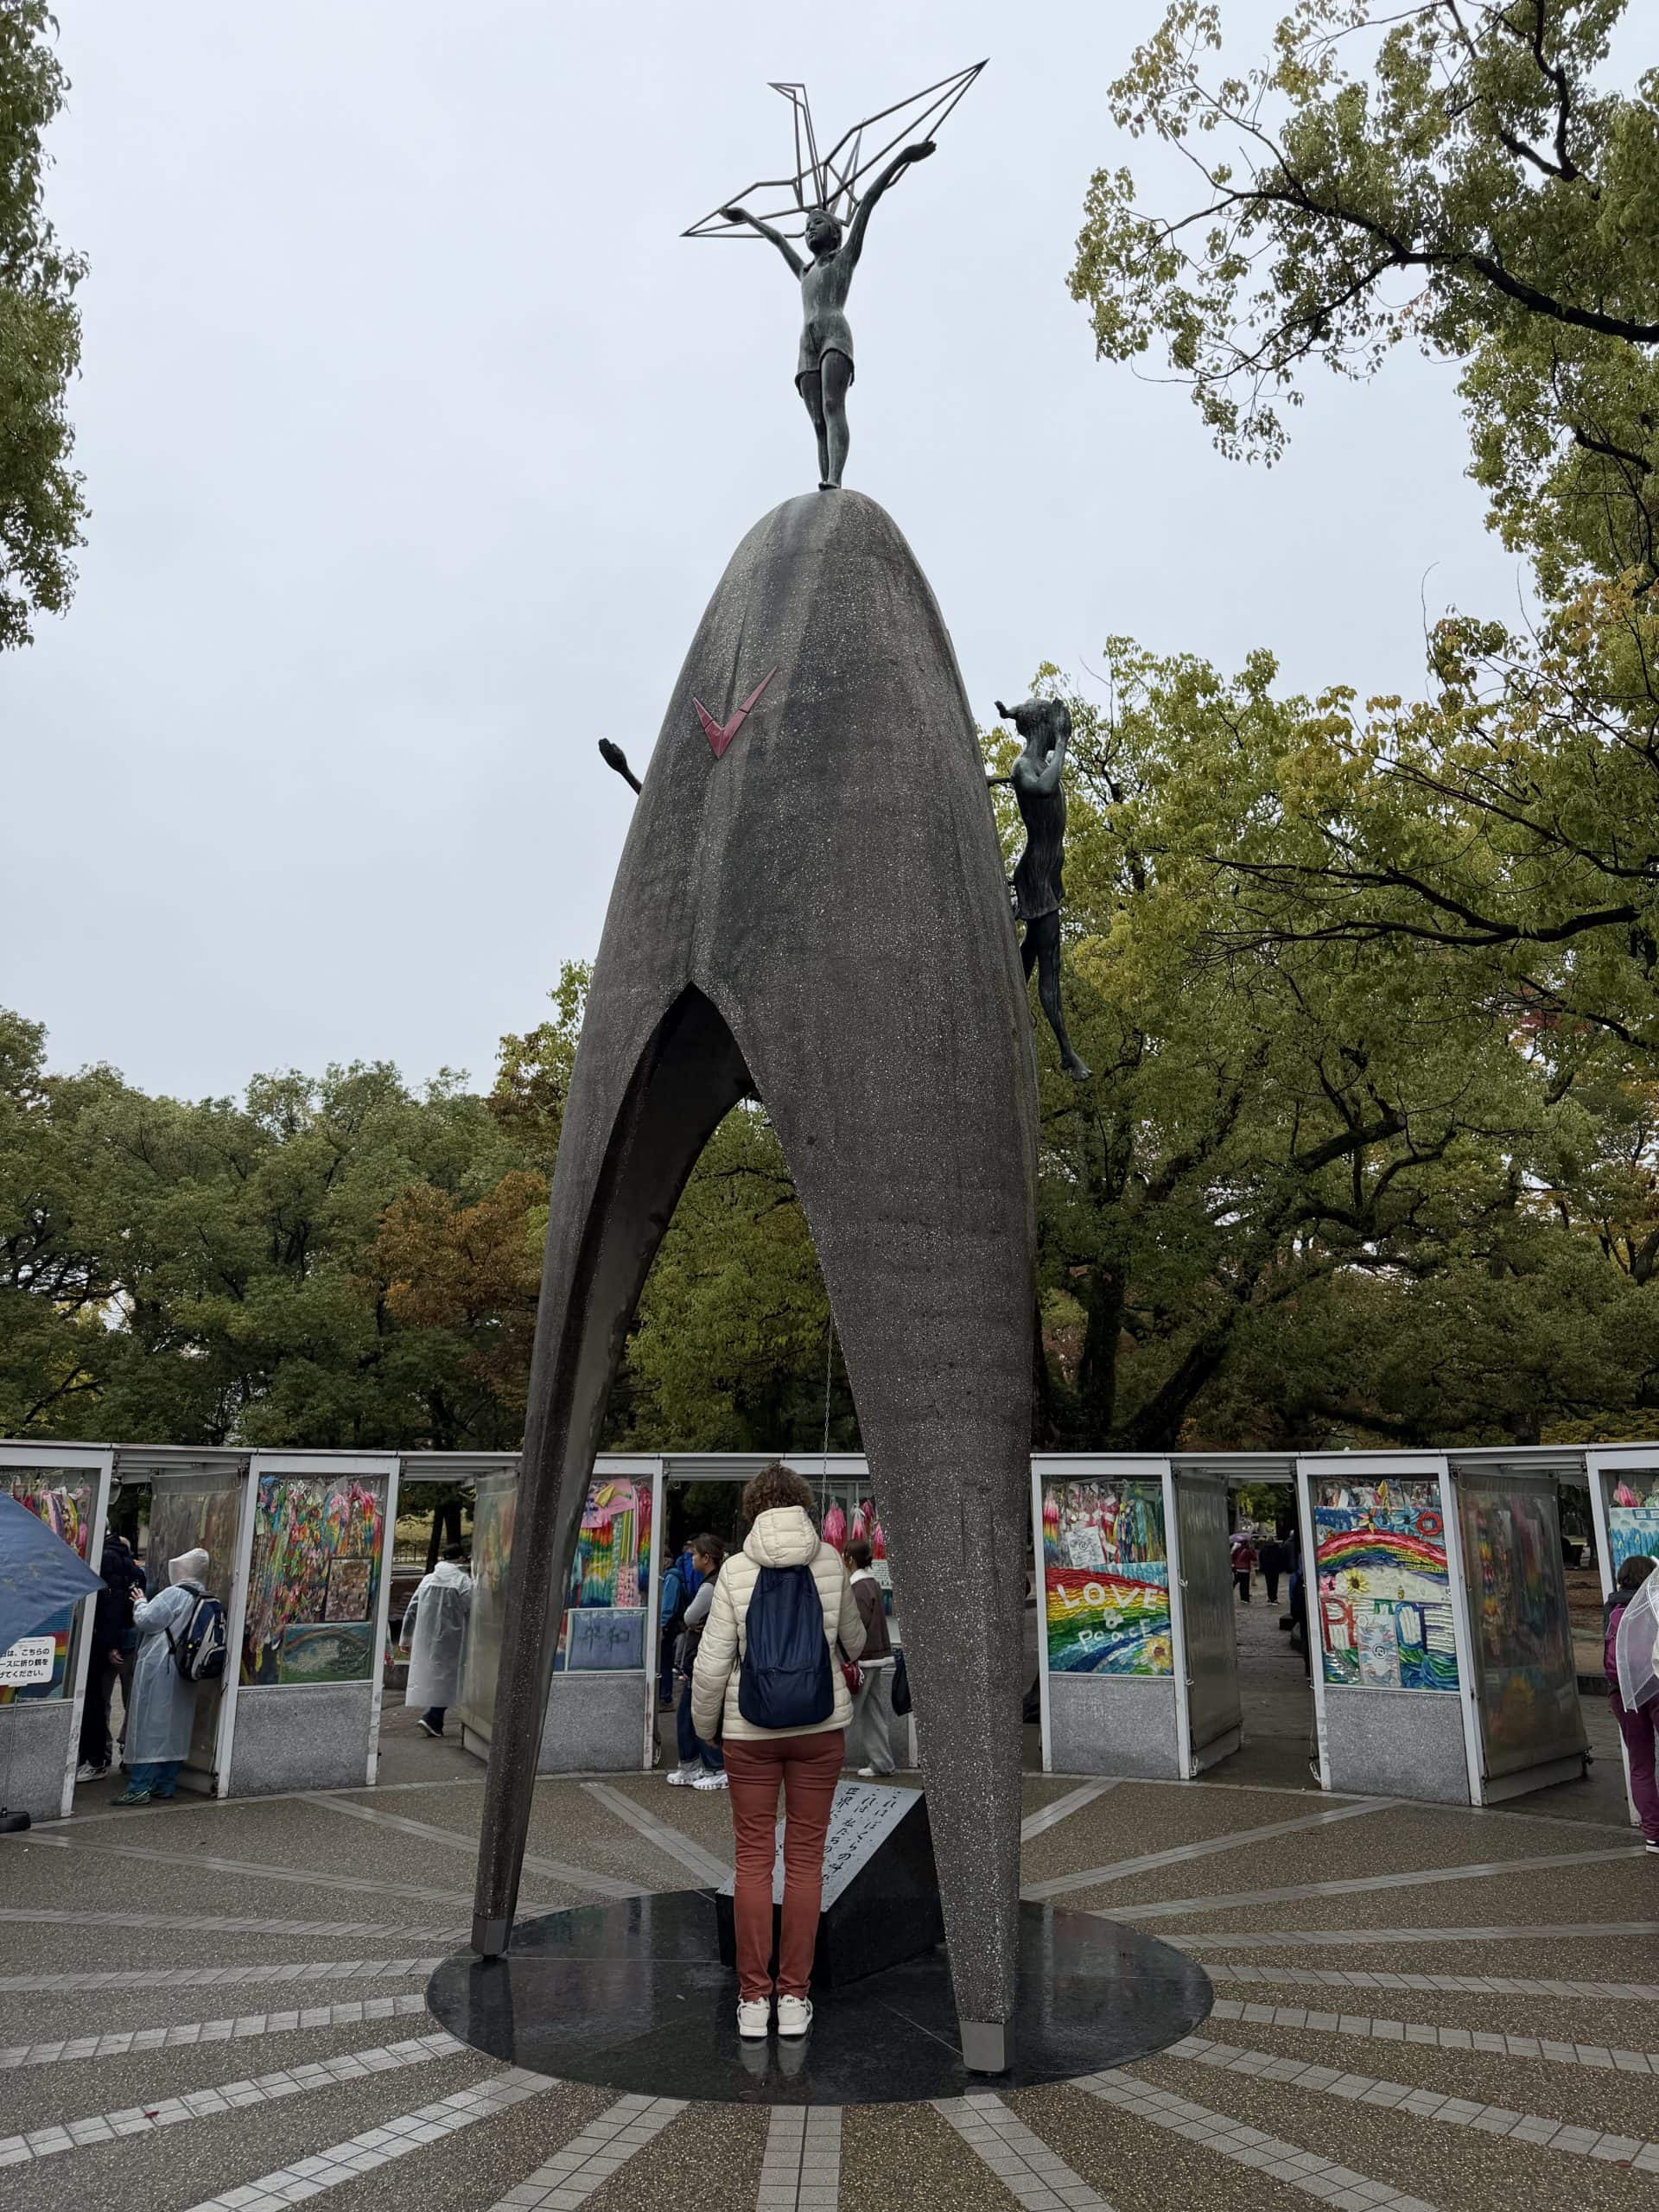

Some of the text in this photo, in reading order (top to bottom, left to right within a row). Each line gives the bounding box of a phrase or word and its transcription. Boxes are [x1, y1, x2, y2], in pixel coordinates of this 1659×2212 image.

[1057, 1582, 1160, 1610] LOVE
[1103, 1609, 1123, 1630] &
[1320, 1598, 1457, 1656] PECE
